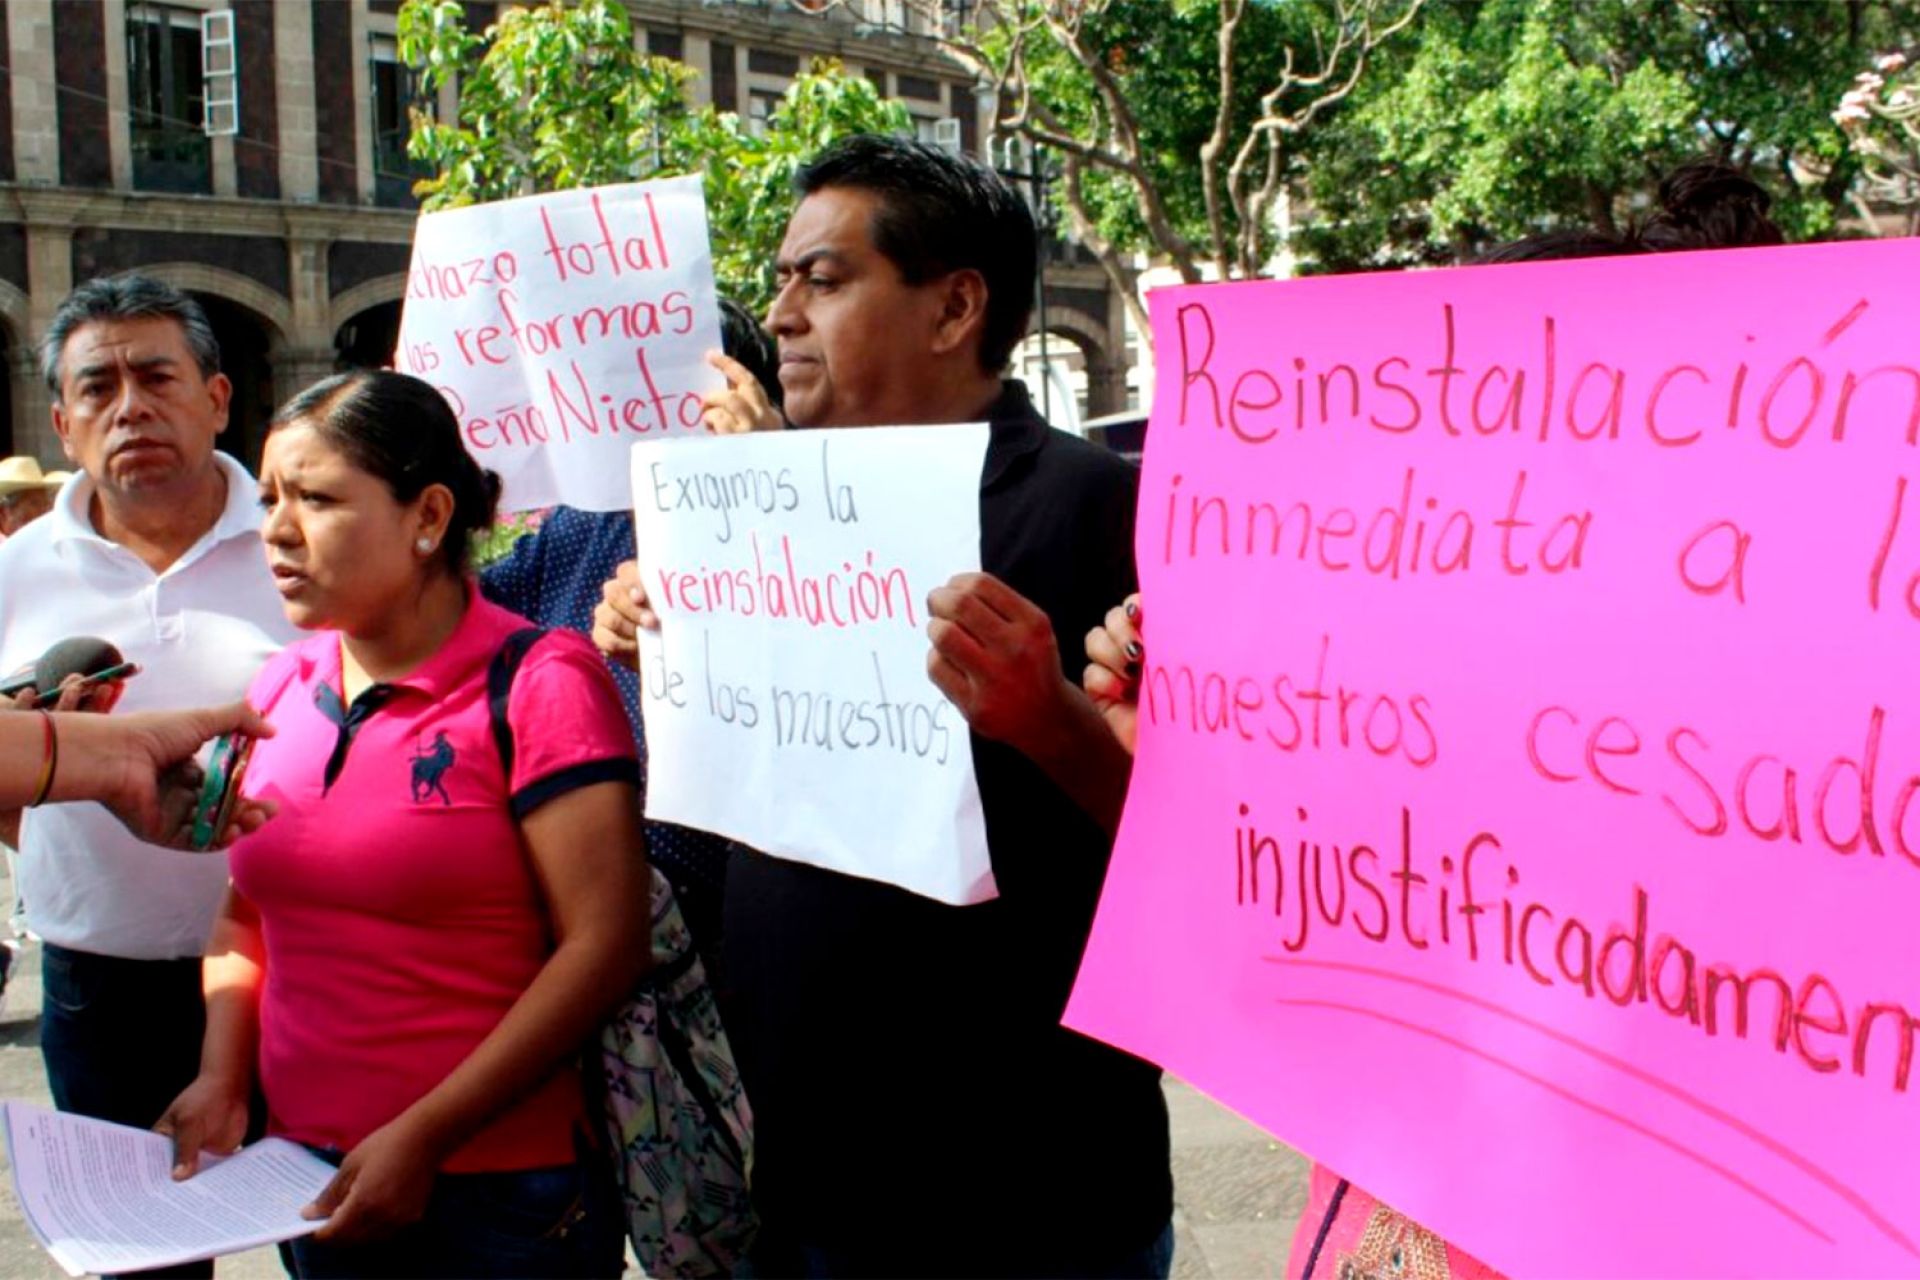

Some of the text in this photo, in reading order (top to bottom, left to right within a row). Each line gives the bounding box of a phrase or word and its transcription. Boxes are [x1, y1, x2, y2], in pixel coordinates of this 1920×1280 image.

[407, 192, 670, 301] chazo total
[403, 288, 694, 374] las reformas
[1176, 297, 1920, 448] Reinstalación
[547, 347, 704, 443] Nieto
[650, 438, 859, 543] Exigimos la
[1164, 467, 1592, 580] inmediata
[1678, 519, 1751, 604] a
[658, 531, 917, 628] reinstalación
[648, 629, 950, 766] de los maestros
[1144, 633, 1438, 769] maestros
[1236, 802, 1920, 1093] injustificadamen
